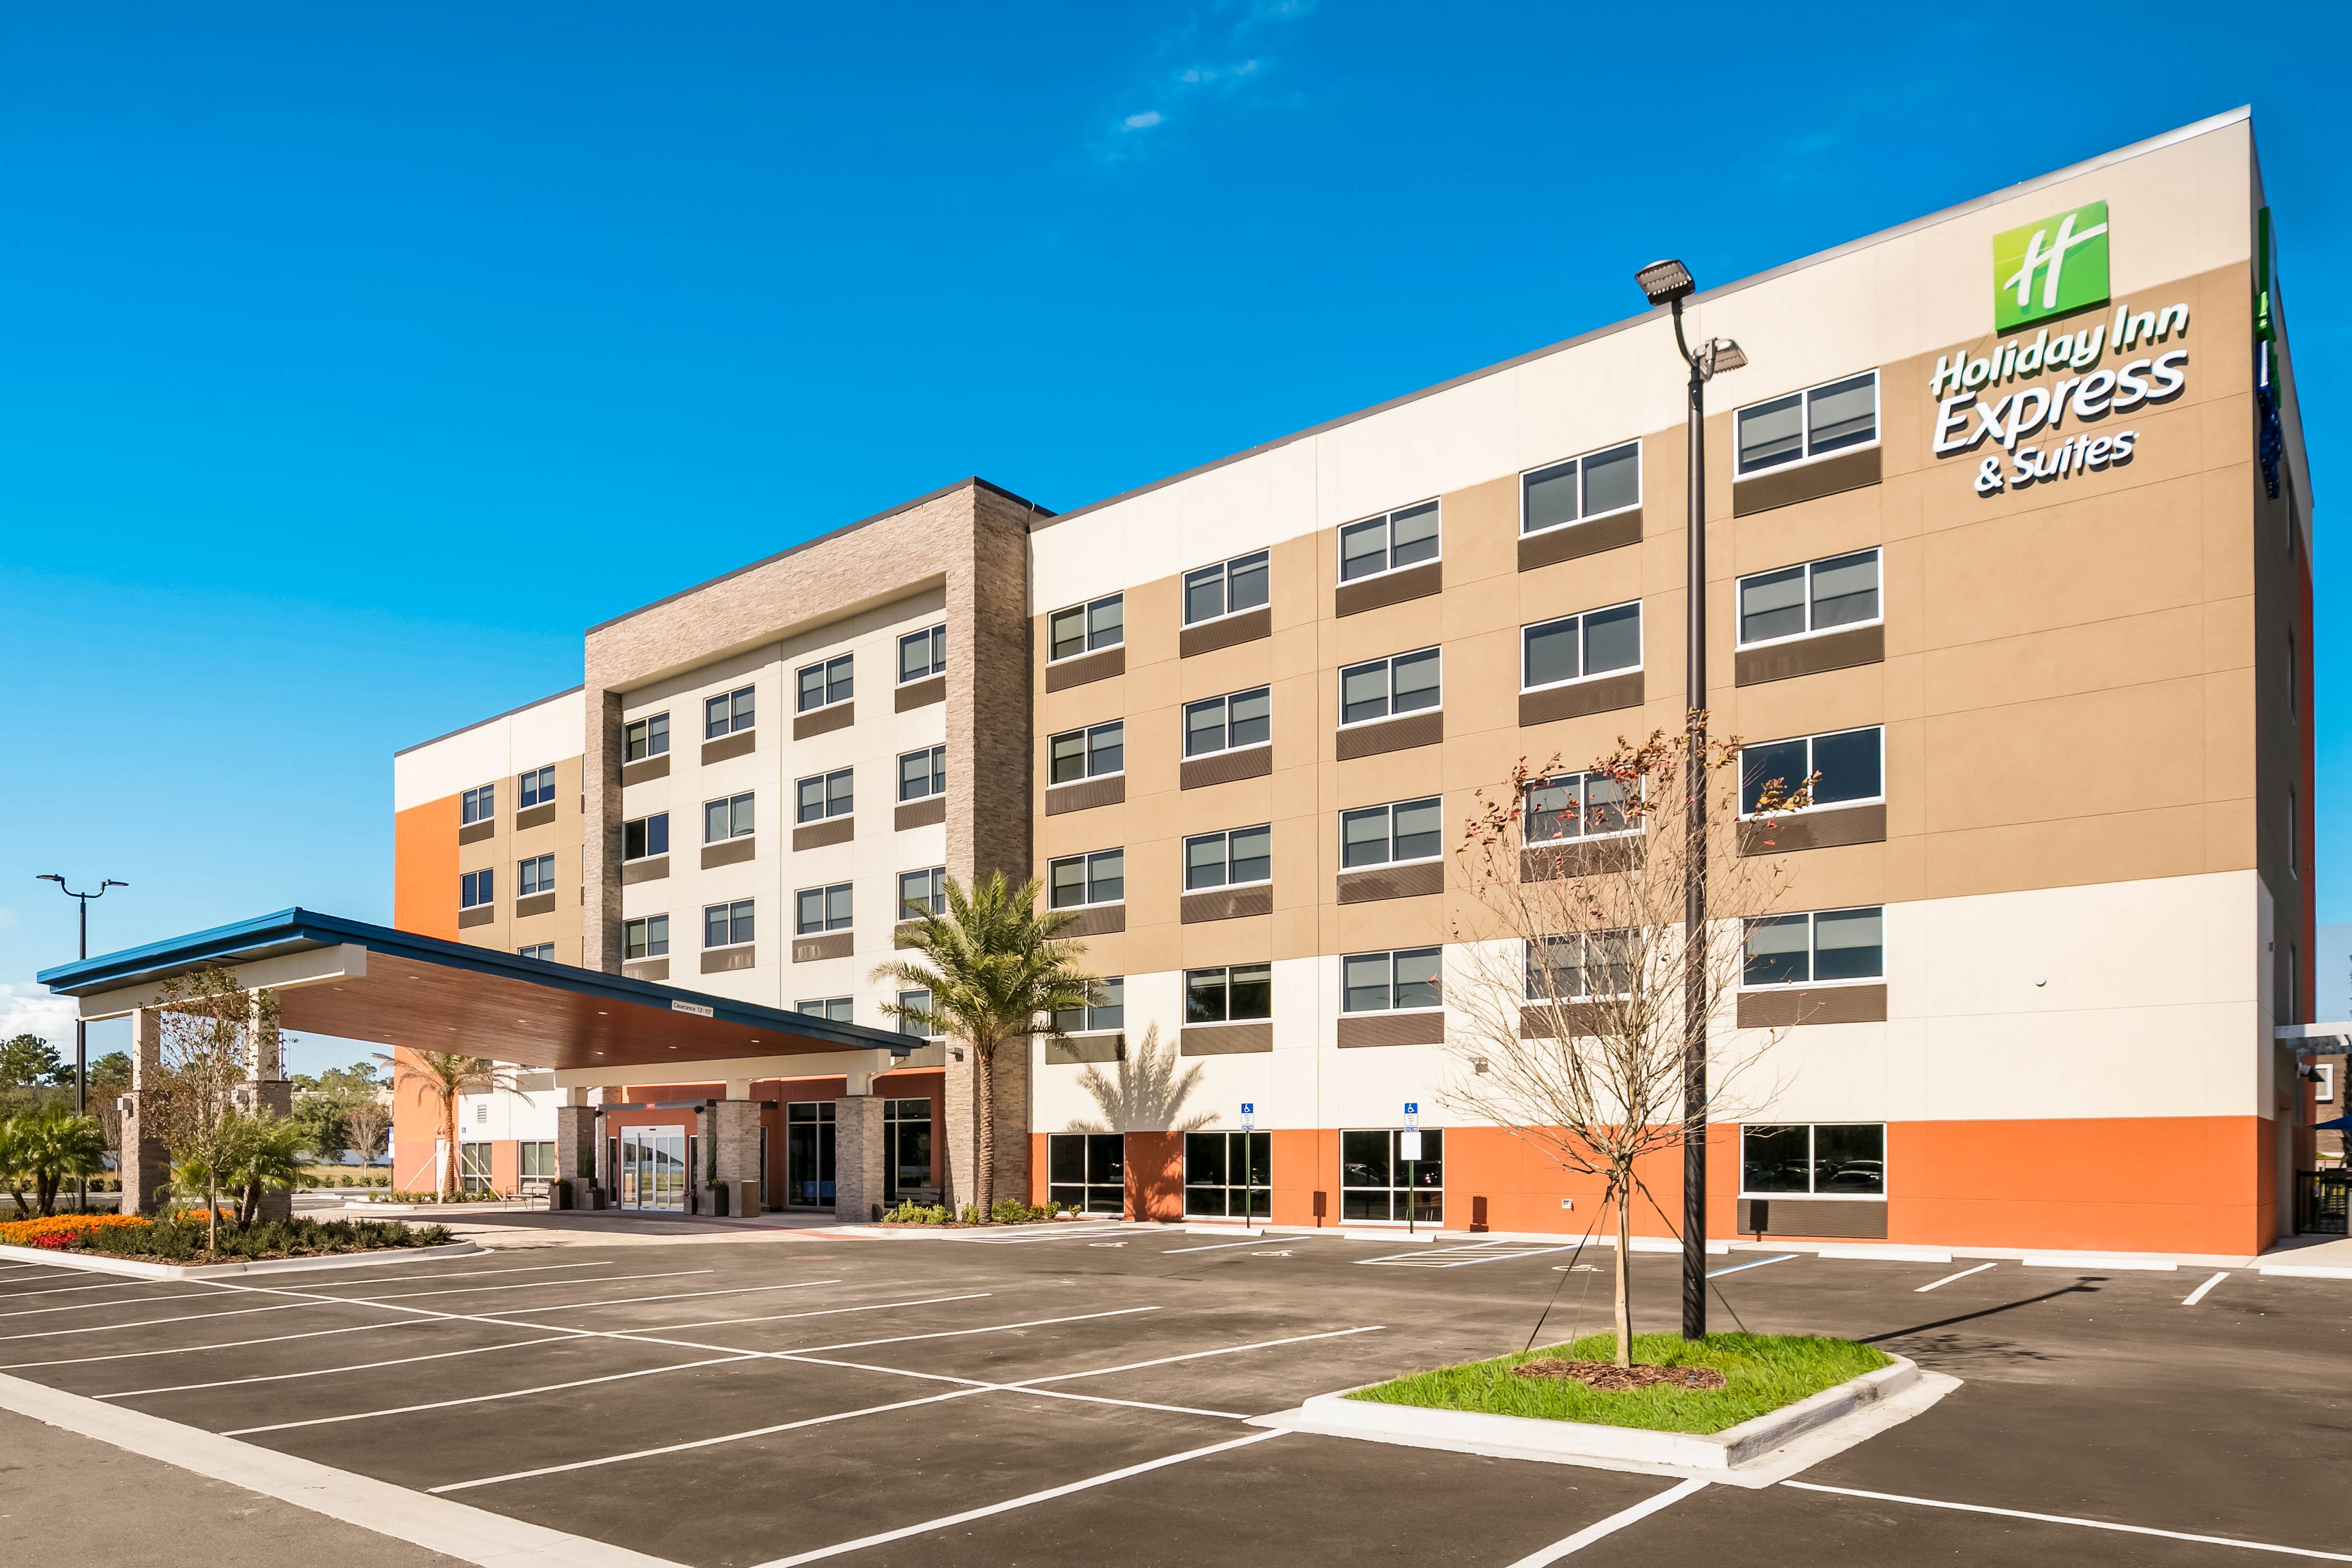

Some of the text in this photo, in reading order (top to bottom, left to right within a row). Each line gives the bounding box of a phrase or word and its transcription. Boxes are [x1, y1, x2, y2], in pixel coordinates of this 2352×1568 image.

[1930, 303, 2189, 396] Holiday Inn
[1933, 349, 2188, 453] Express
[1974, 431, 2136, 491] & Suites
[674, 1003, 696, 1011] Clearance
